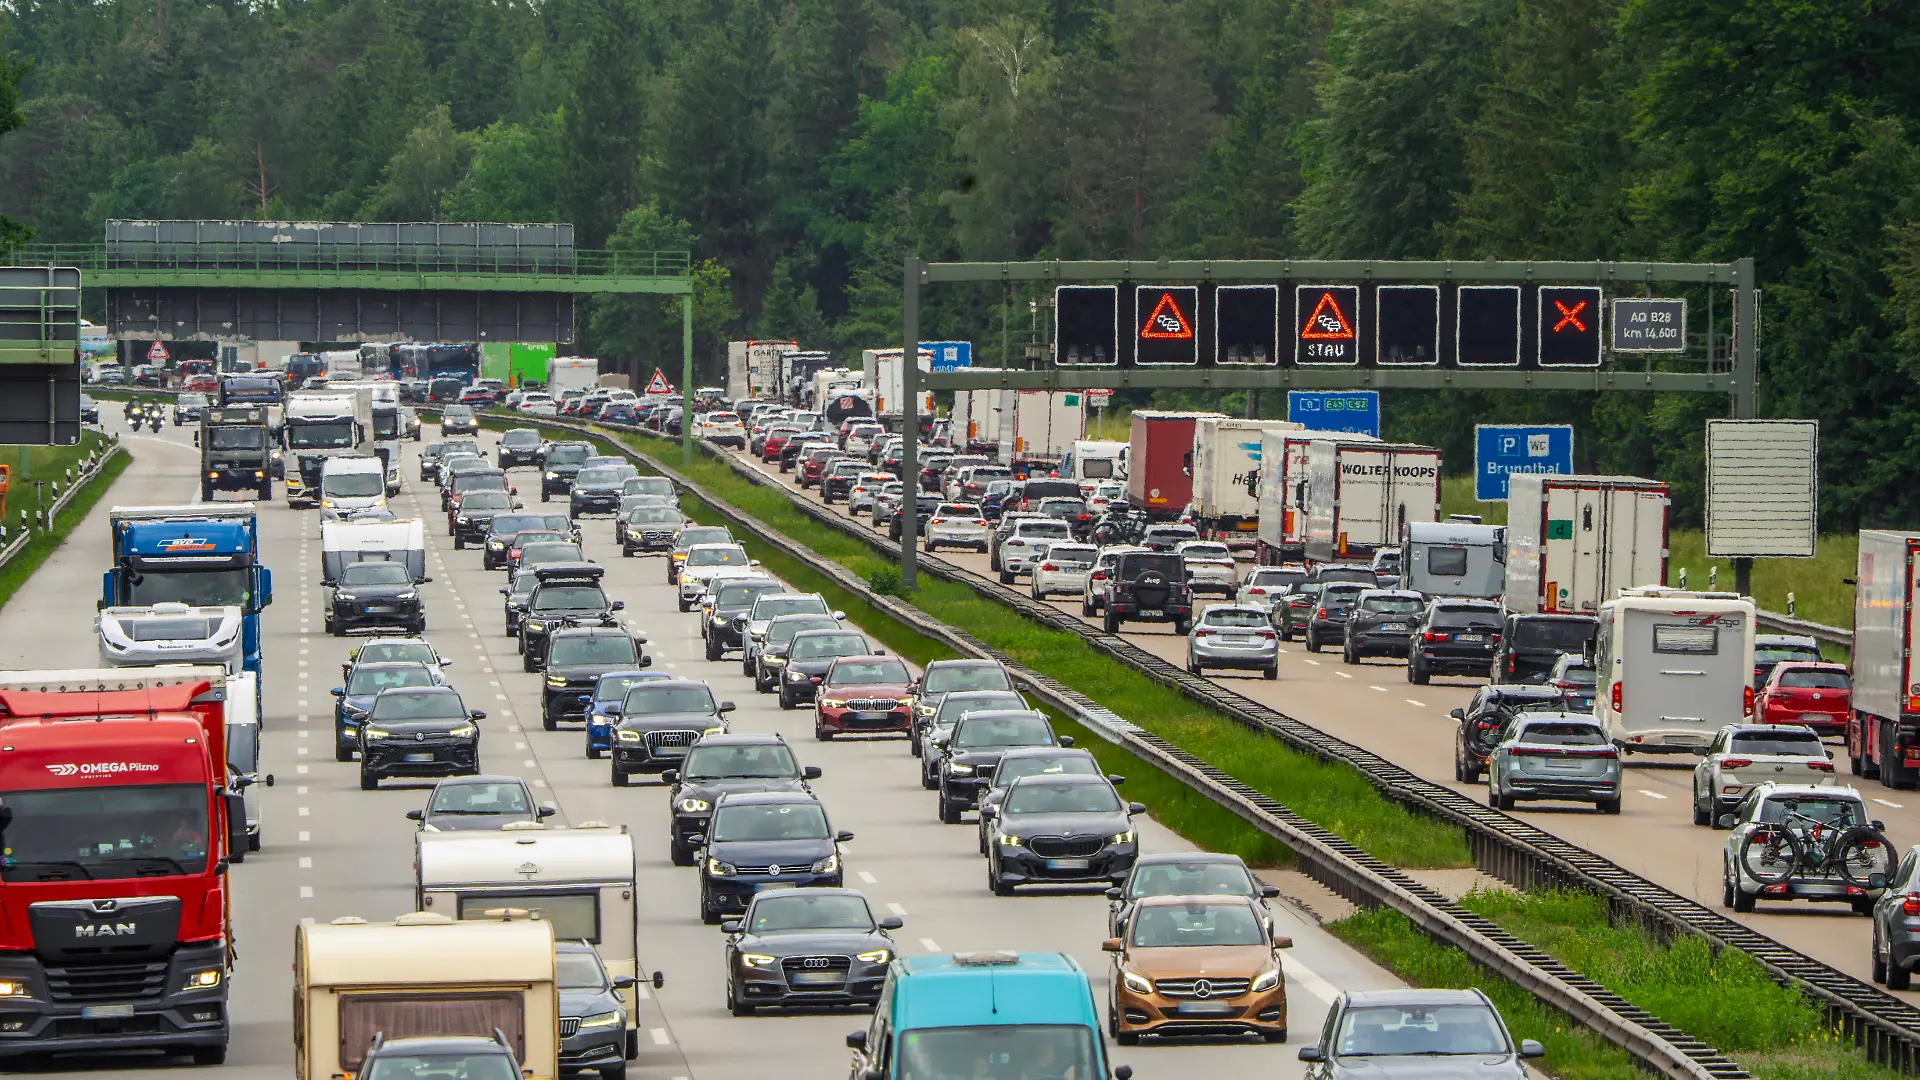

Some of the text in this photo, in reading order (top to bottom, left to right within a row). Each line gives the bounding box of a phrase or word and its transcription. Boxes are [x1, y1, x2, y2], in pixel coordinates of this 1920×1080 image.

[1630, 312, 1671, 322] AQ B28
[1624, 328, 1677, 338] km 14,600
[1308, 344, 1344, 357] STAU
[1503, 437, 1516, 453] P
[1529, 441, 1546, 451] WC
[1394, 466, 1436, 477] KOOPS
[1556, 525, 1565, 535] d
[80, 763, 159, 773] OMEGA Pilzno
[75, 923, 136, 937] MAN
